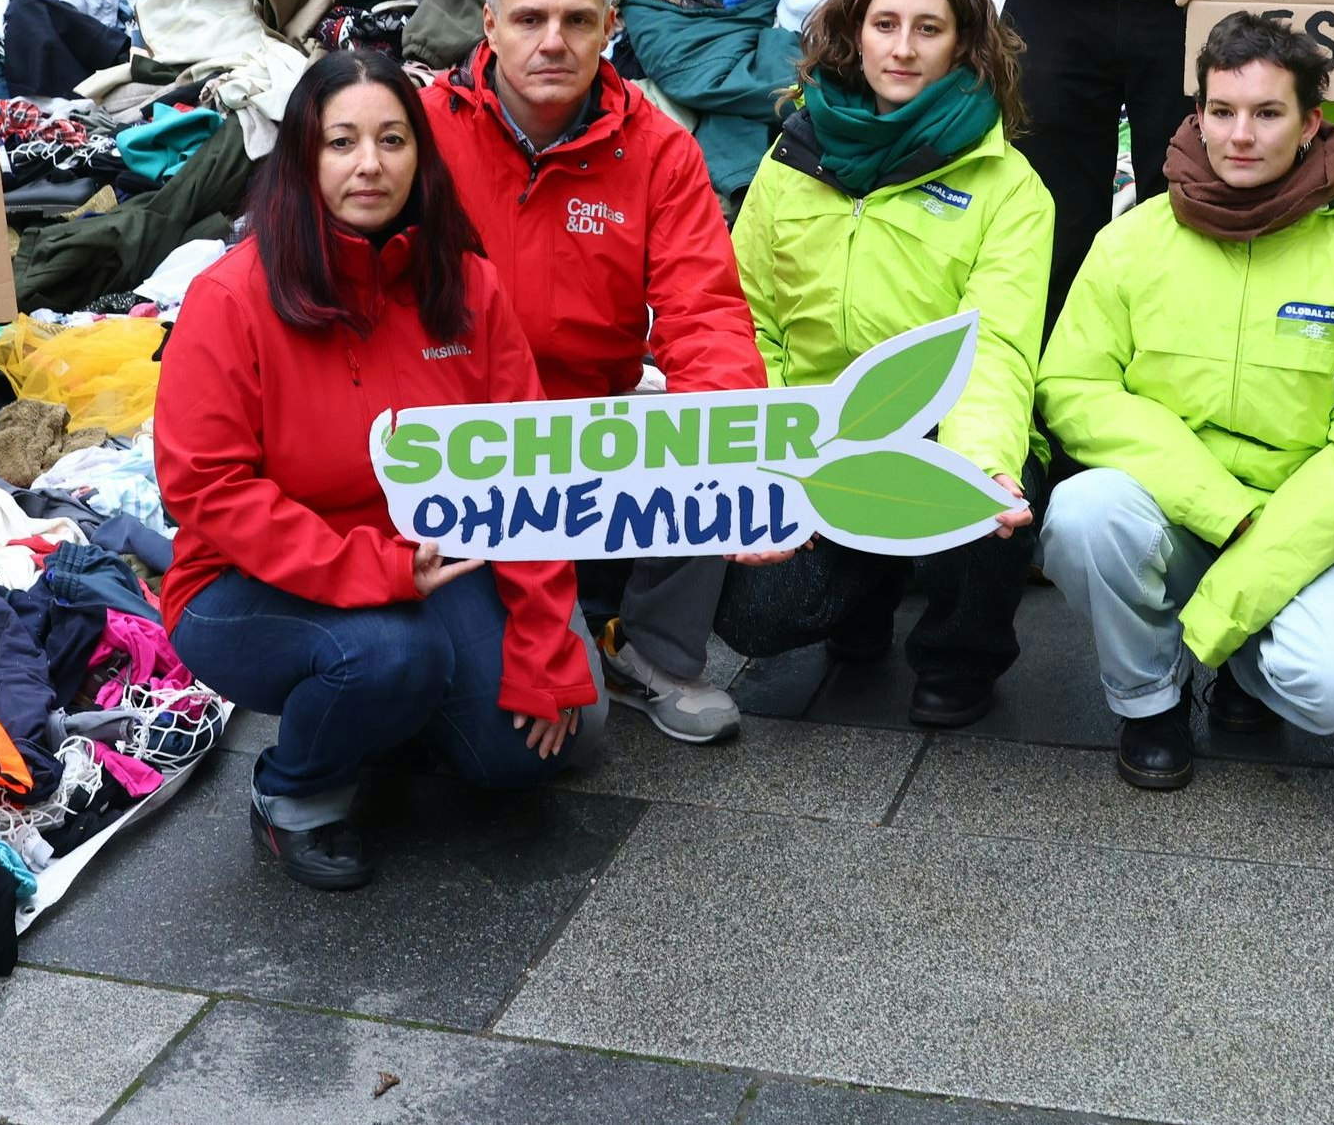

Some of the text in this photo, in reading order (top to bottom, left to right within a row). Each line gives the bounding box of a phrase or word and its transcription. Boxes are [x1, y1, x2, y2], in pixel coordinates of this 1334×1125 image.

[947, 193, 968, 205] 2000
[567, 197, 625, 224] Caritas
[566, 215, 605, 235] &Du
[1285, 305, 1324, 319] GLOBAL
[382, 400, 820, 485] SCHÖNER
